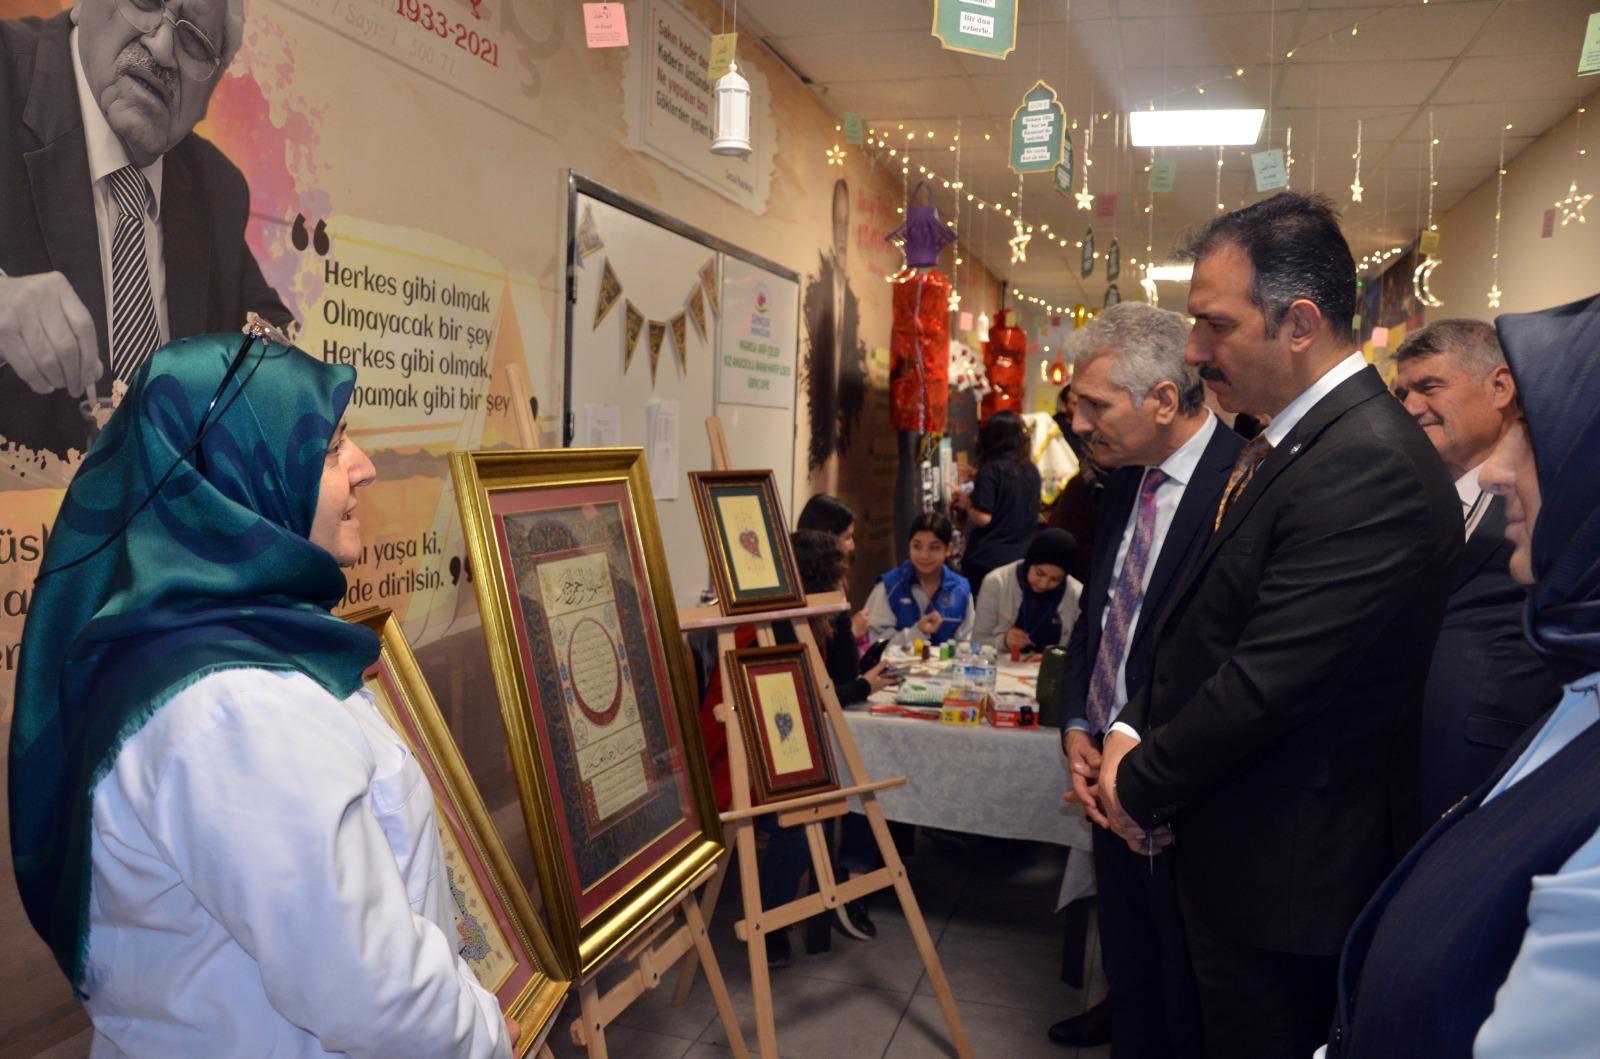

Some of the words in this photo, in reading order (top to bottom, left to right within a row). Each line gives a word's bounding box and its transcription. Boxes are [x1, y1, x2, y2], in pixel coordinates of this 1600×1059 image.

[396, 0, 499, 67] 1933-2021
[325, 259, 397, 296] Herkes
[403, 276, 436, 306] gibi
[441, 282, 490, 313] olmak
[323, 299, 434, 338] Olmayacak
[439, 316, 463, 341] bir
[467, 326, 493, 352] şey
[323, 339, 395, 370] Herkes
[401, 347, 434, 379] gibi
[423, 385, 455, 415] gibi
[460, 387, 482, 410] bir
[486, 393, 511, 418] şey
[374, 540, 417, 570] yaşa
[423, 531, 442, 555] ki,
[378, 566, 444, 598] dirilsin.
